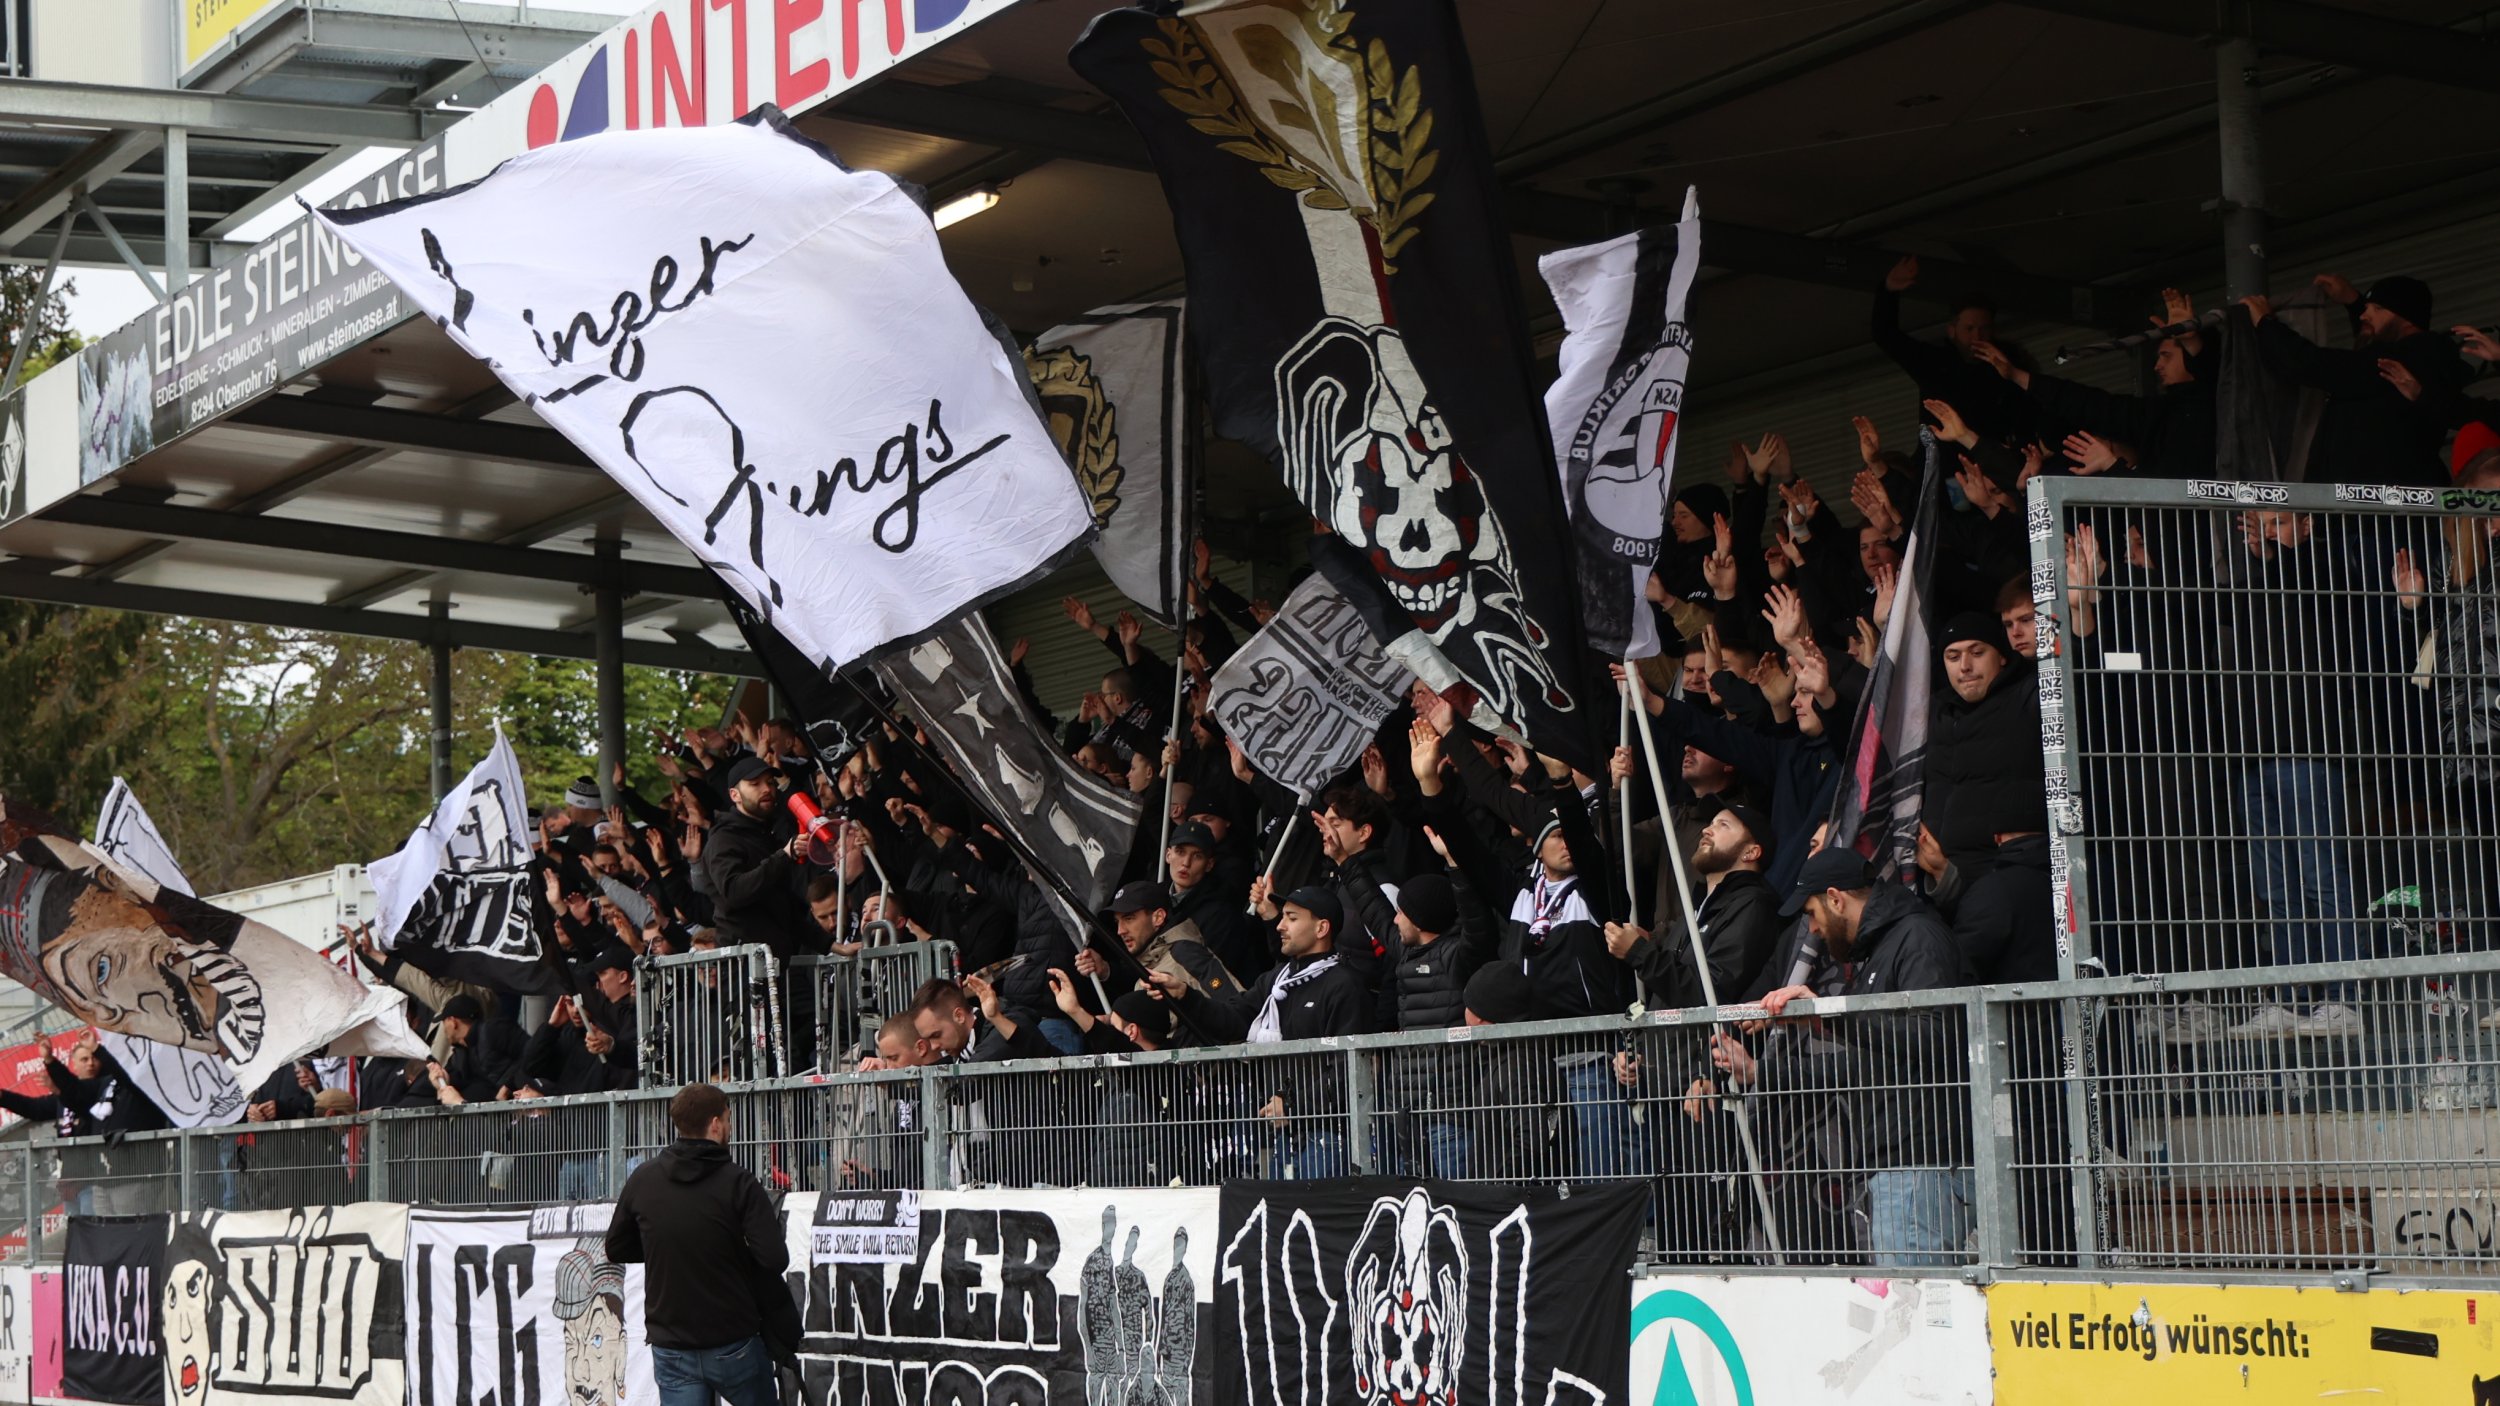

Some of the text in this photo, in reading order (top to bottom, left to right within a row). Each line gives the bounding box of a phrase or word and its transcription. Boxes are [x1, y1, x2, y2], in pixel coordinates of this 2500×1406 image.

[155, 268, 233, 376] EDLE
[297, 296, 398, 367] www.steinoase.at
[156, 366, 209, 408] EDELSTEINE
[217, 337, 264, 376] SCHMUCK
[271, 297, 334, 346] MINERALIEN
[191, 358, 278, 423] 8294 Oberrohr 76
[2187, 479, 2288, 503] BASTION NORD
[2335, 484, 2434, 504] BASTION NORD
[2029, 508, 2050, 523] INZ
[2029, 519, 2051, 535] 995
[2032, 570, 2054, 583] INZ
[2033, 581, 2054, 595] 995
[2041, 678, 2062, 690] INZ
[2040, 689, 2062, 702] 995
[2043, 724, 2064, 735] INZ
[2043, 735, 2064, 748] 995
[2046, 777, 2067, 788] INZ
[2046, 789, 2068, 801] 995
[2056, 916, 2069, 959] NORD
[827, 1199, 885, 1221] DON'T WORRY
[815, 1234, 918, 1256] THE SMILE WILL RETURN
[68, 1263, 110, 1352] VIVA
[2010, 1312, 2061, 1349] viel
[2167, 1314, 2310, 1359] wünscht:
